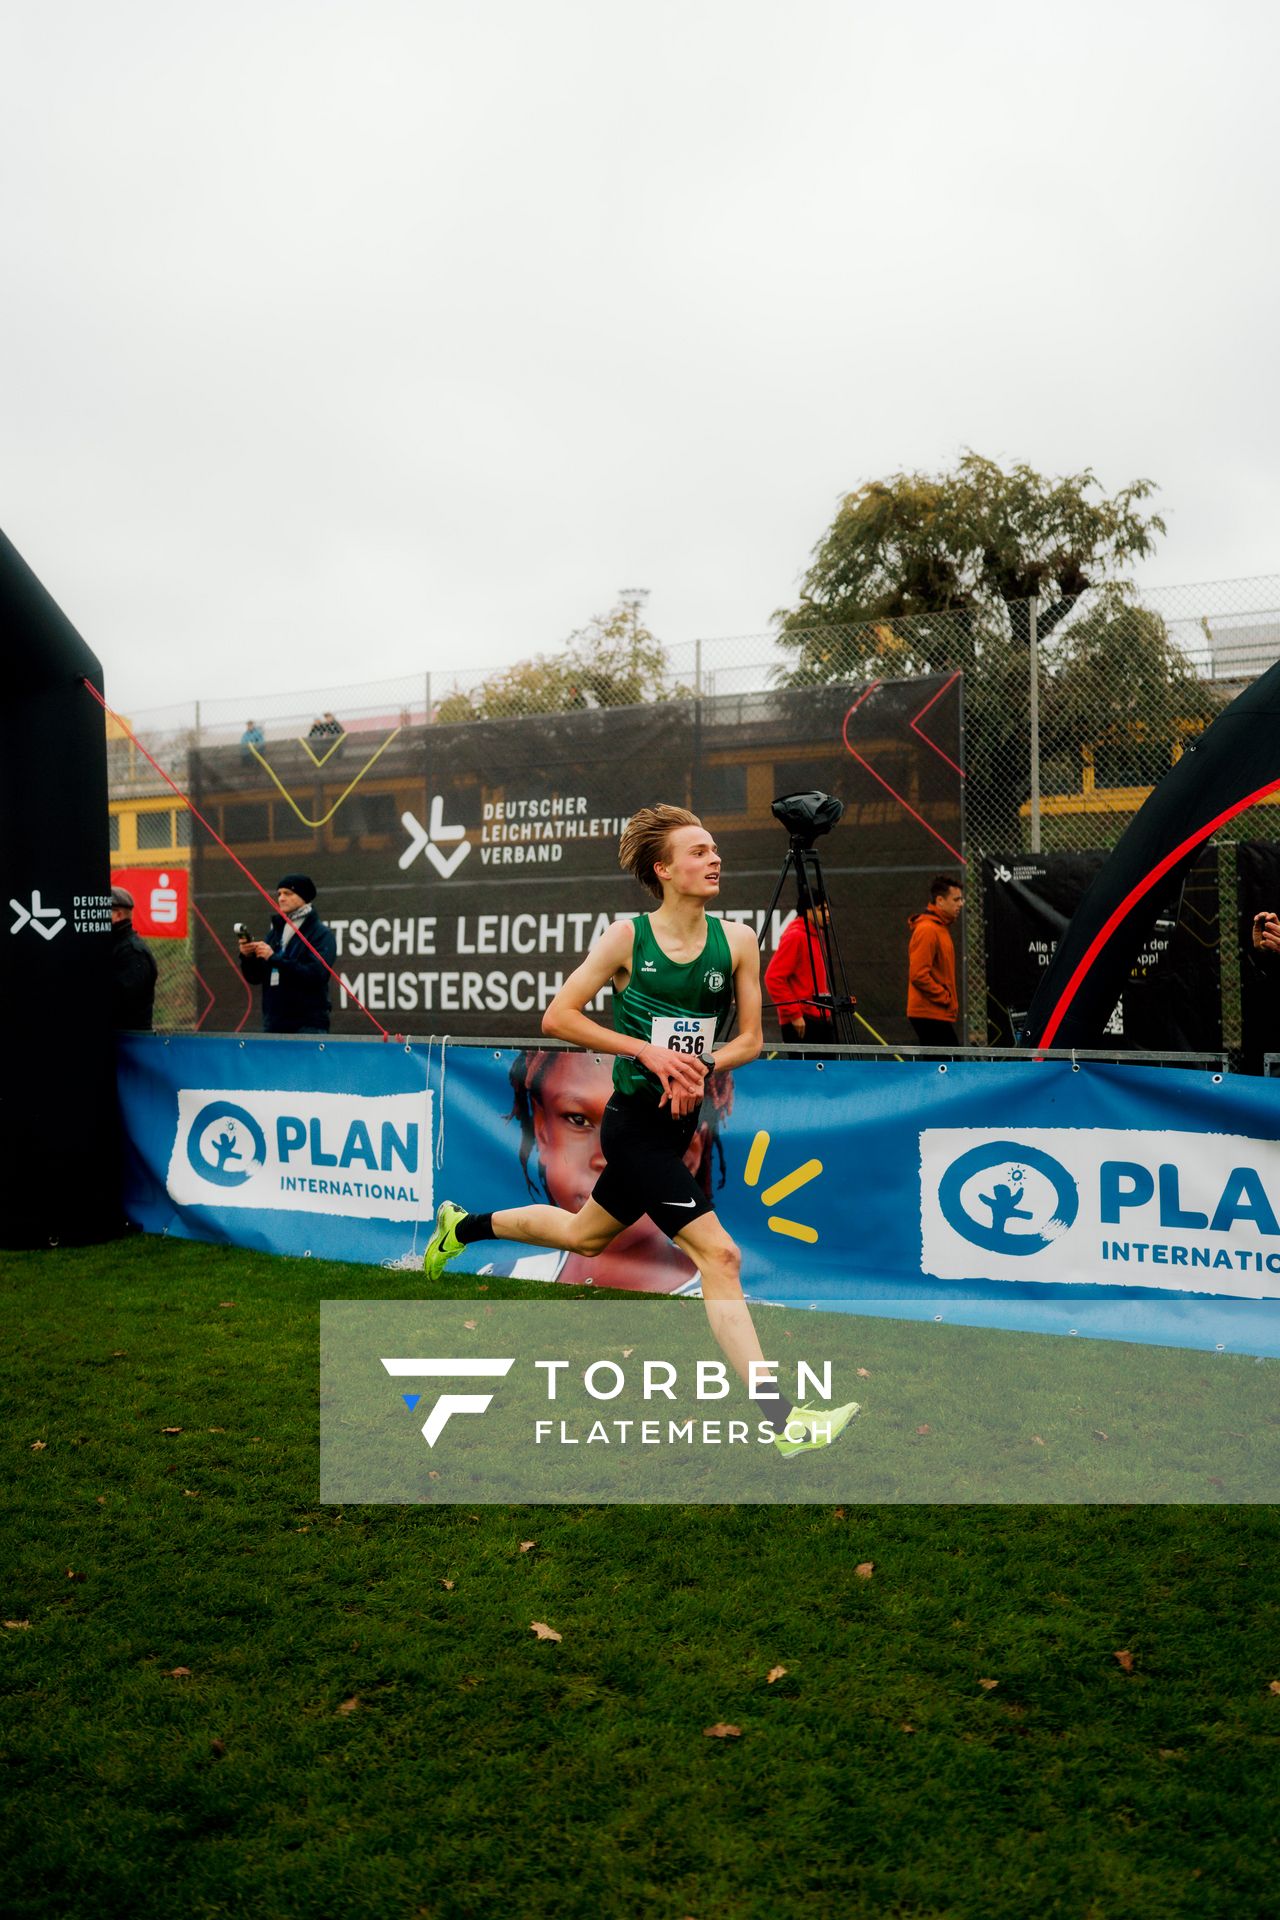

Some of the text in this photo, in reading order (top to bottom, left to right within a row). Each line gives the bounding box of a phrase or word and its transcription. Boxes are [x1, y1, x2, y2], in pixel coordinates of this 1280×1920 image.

[483, 797, 588, 821] DEUTSCHER
[480, 844, 563, 865] VERBAND
[322, 917, 438, 957] TSCHE
[1028, 941, 1048, 953] Alle
[1150, 938, 1169, 951] der
[667, 1034, 705, 1056] 636
[276, 1115, 420, 1174] PLAN
[280, 1175, 420, 1203] INTERNATIONAL
[1100, 1160, 1280, 1236] PLA
[1102, 1240, 1280, 1274] INTERNATIO
